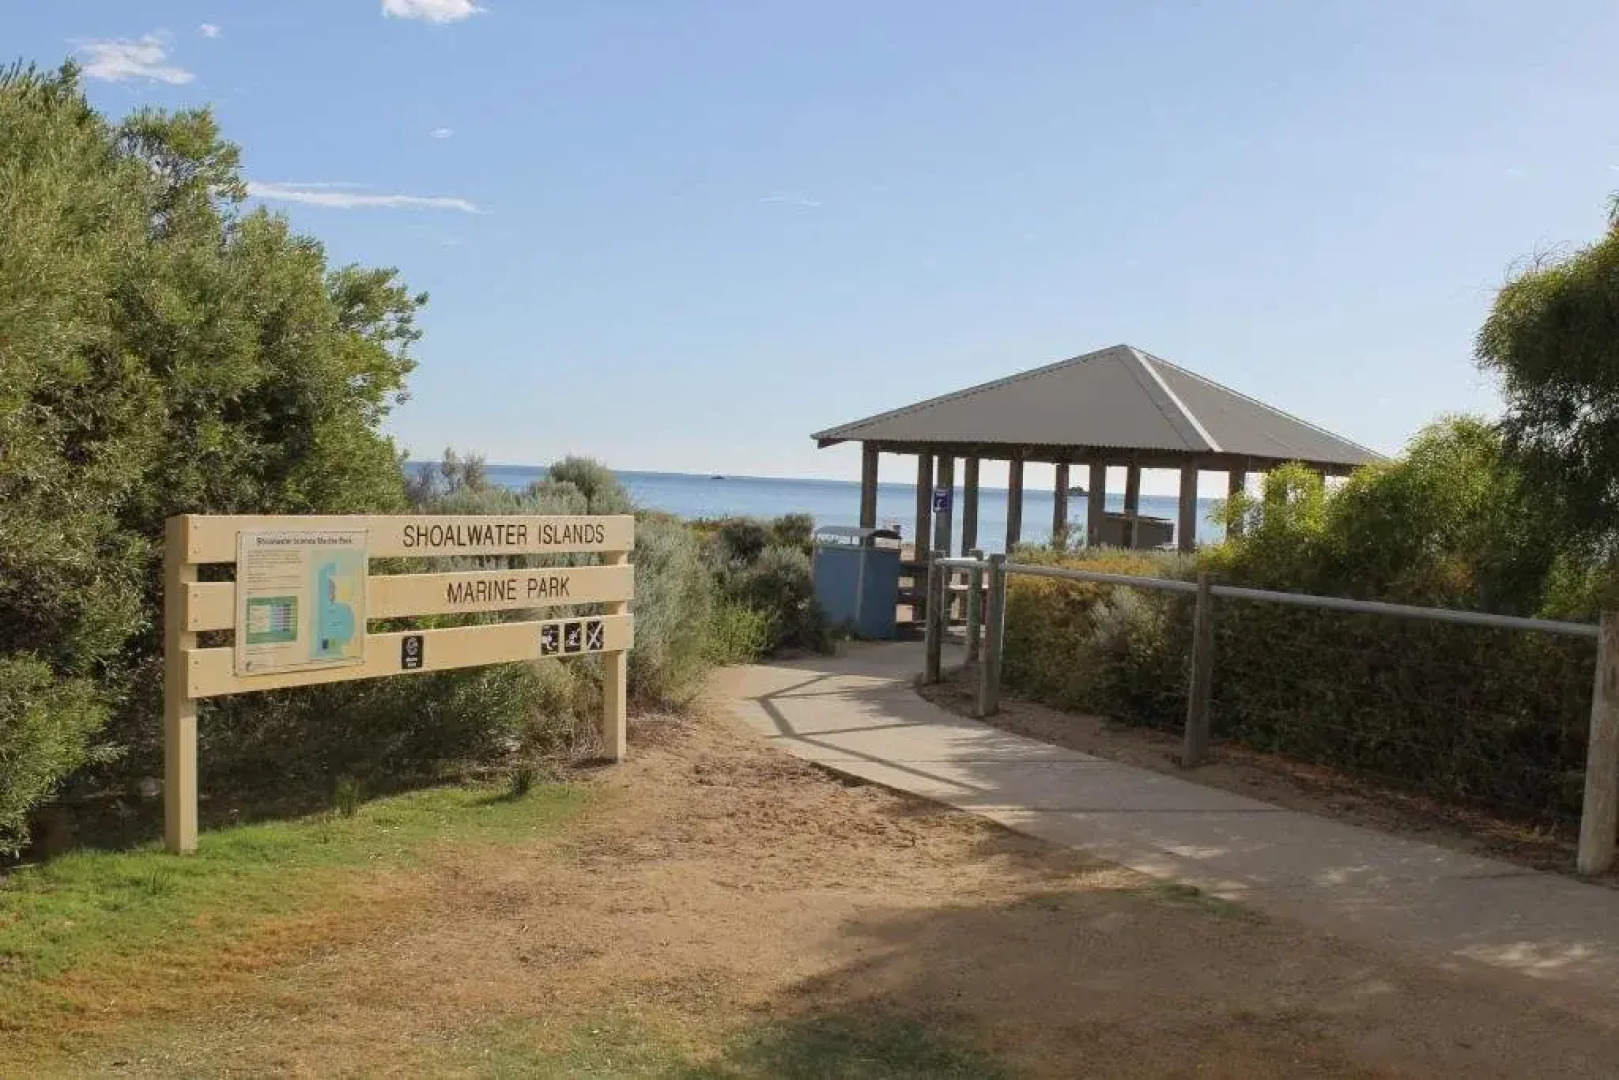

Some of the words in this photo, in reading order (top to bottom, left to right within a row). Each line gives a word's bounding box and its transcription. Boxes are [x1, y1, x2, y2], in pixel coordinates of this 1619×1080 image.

[403, 525, 527, 547] SHOALWATER
[538, 524, 605, 544] ISLANDS
[447, 579, 517, 604] MARINE
[527, 577, 570, 598] PARK
